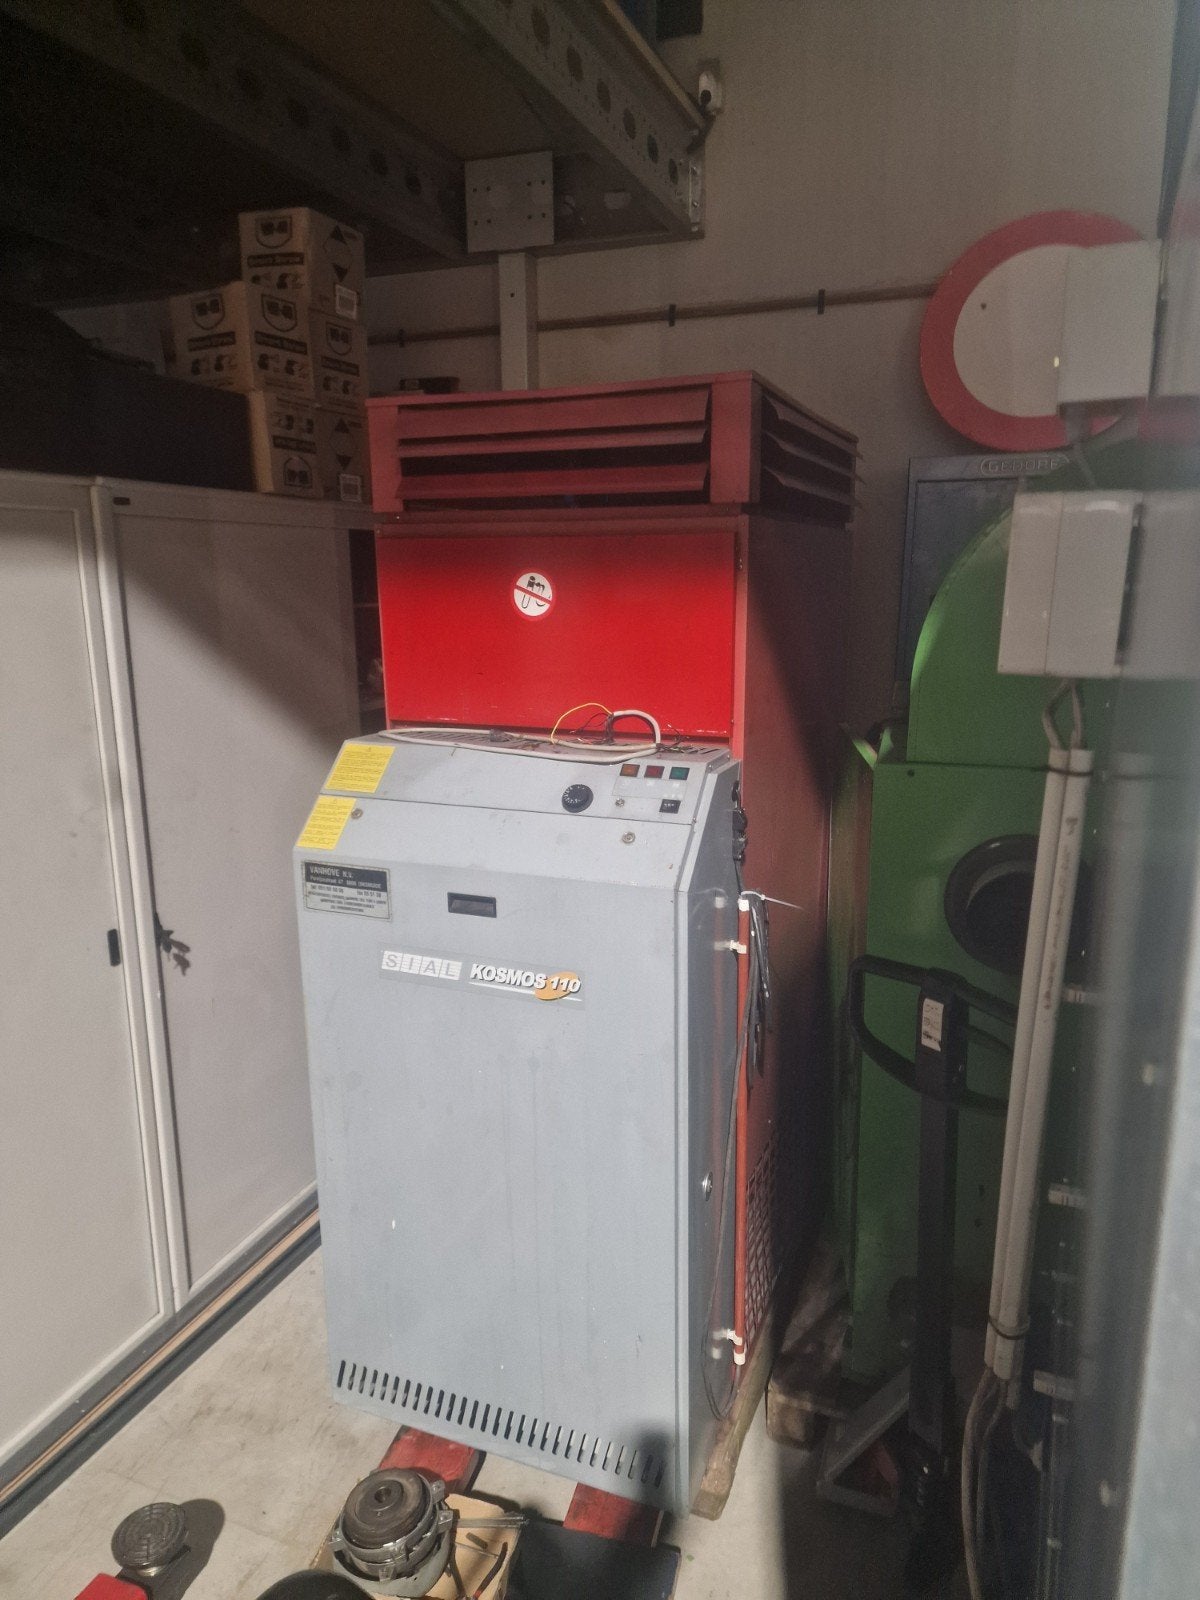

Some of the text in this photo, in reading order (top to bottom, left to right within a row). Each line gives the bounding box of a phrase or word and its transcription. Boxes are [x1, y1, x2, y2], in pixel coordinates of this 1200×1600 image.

[310, 866, 340, 877] VANHOVE
[384, 952, 582, 993] SIAL KOSMOS 110
